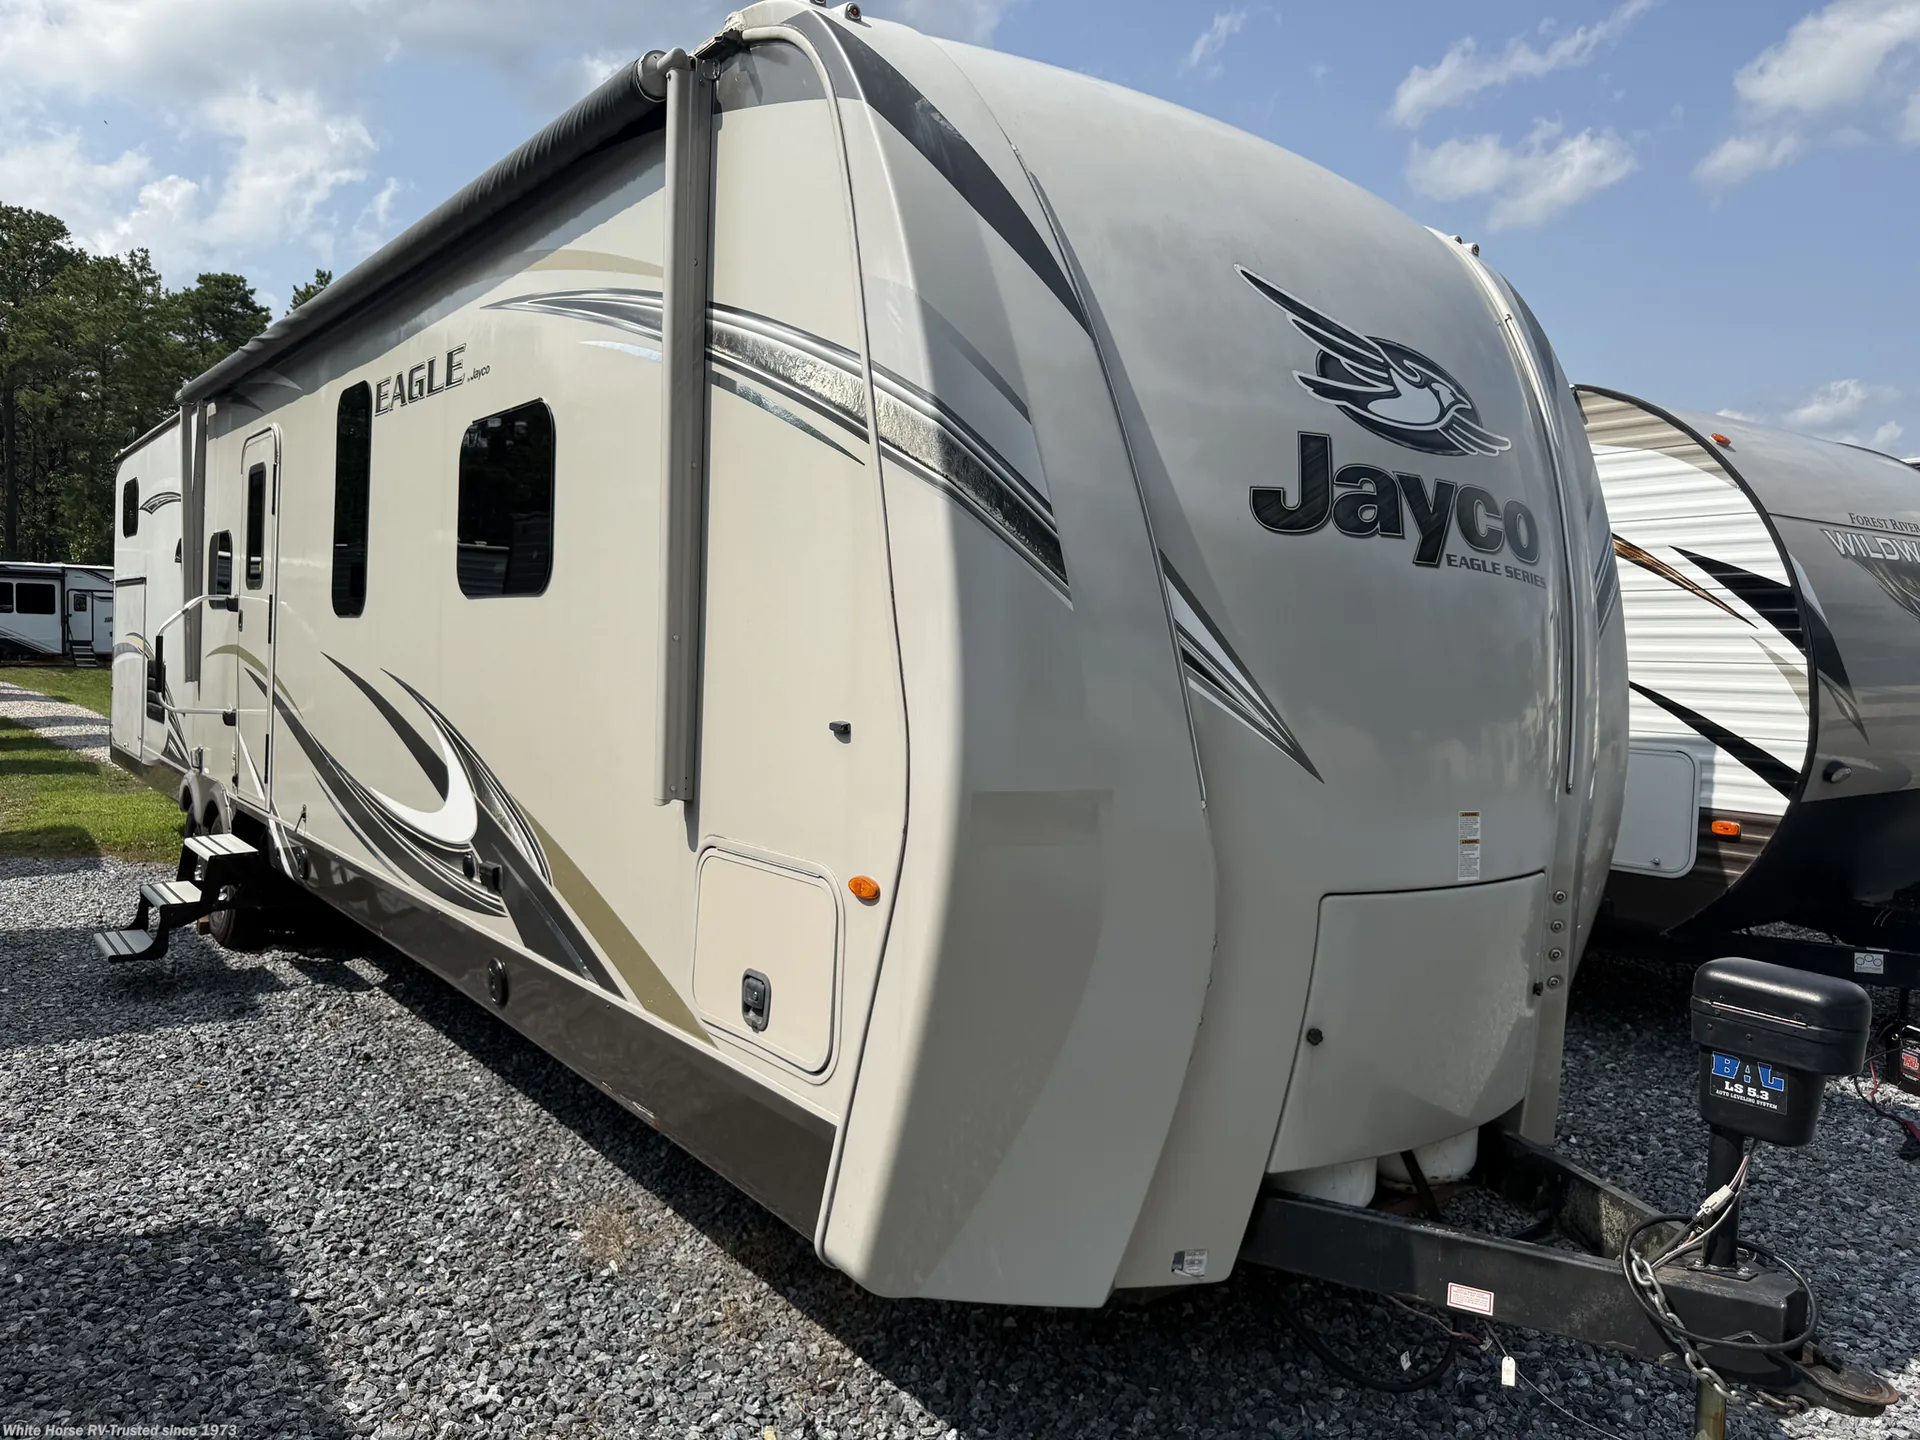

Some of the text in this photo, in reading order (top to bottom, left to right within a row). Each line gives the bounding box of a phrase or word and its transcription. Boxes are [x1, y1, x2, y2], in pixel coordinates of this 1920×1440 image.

[375, 343, 467, 417] EAGLE
[1249, 431, 1541, 568] Jayco
[1820, 528, 1920, 563] WILDW
[1445, 553, 1547, 590] EAGLE SERIES
[1715, 1089, 1778, 1110] AUTO LEVELING SYSTEM
[1724, 1080, 1770, 1101] LS 5.3
